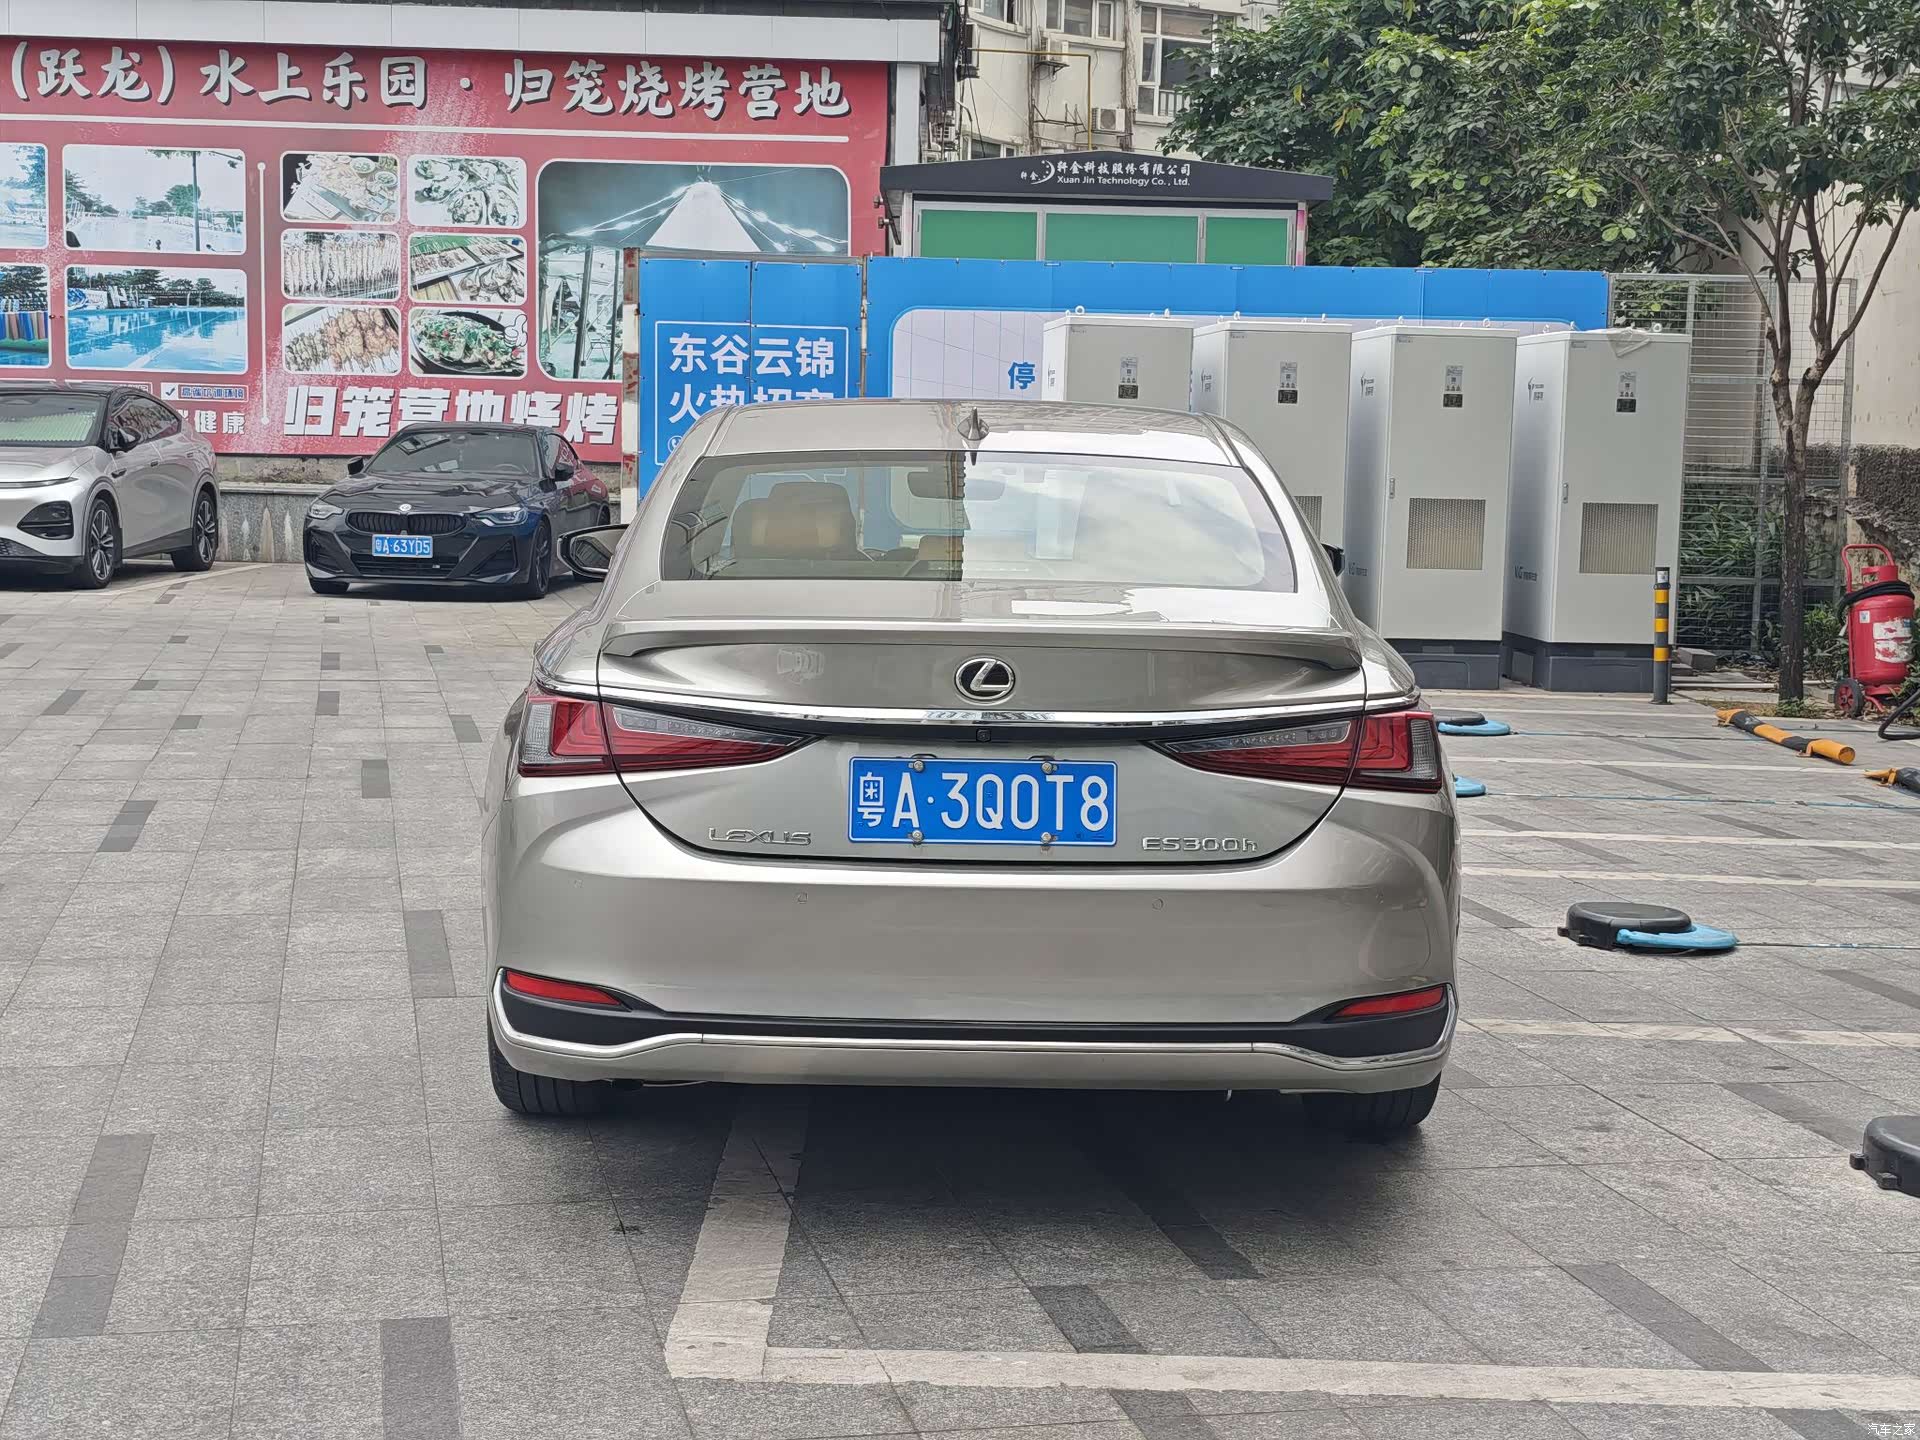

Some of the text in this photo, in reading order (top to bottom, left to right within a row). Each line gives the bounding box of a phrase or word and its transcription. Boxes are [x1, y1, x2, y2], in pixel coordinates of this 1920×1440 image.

[1057, 176, 1080, 184] Xuan
[1082, 176, 1095, 184] Jin
[1097, 177, 1150, 187] Technology
[669, 332, 834, 378] 东谷云锦
[1008, 361, 1036, 390] 停
[284, 386, 617, 444] 归笼营地烧烤
[708, 827, 811, 845] LEXUS
[1142, 837, 1258, 852] ES300h
